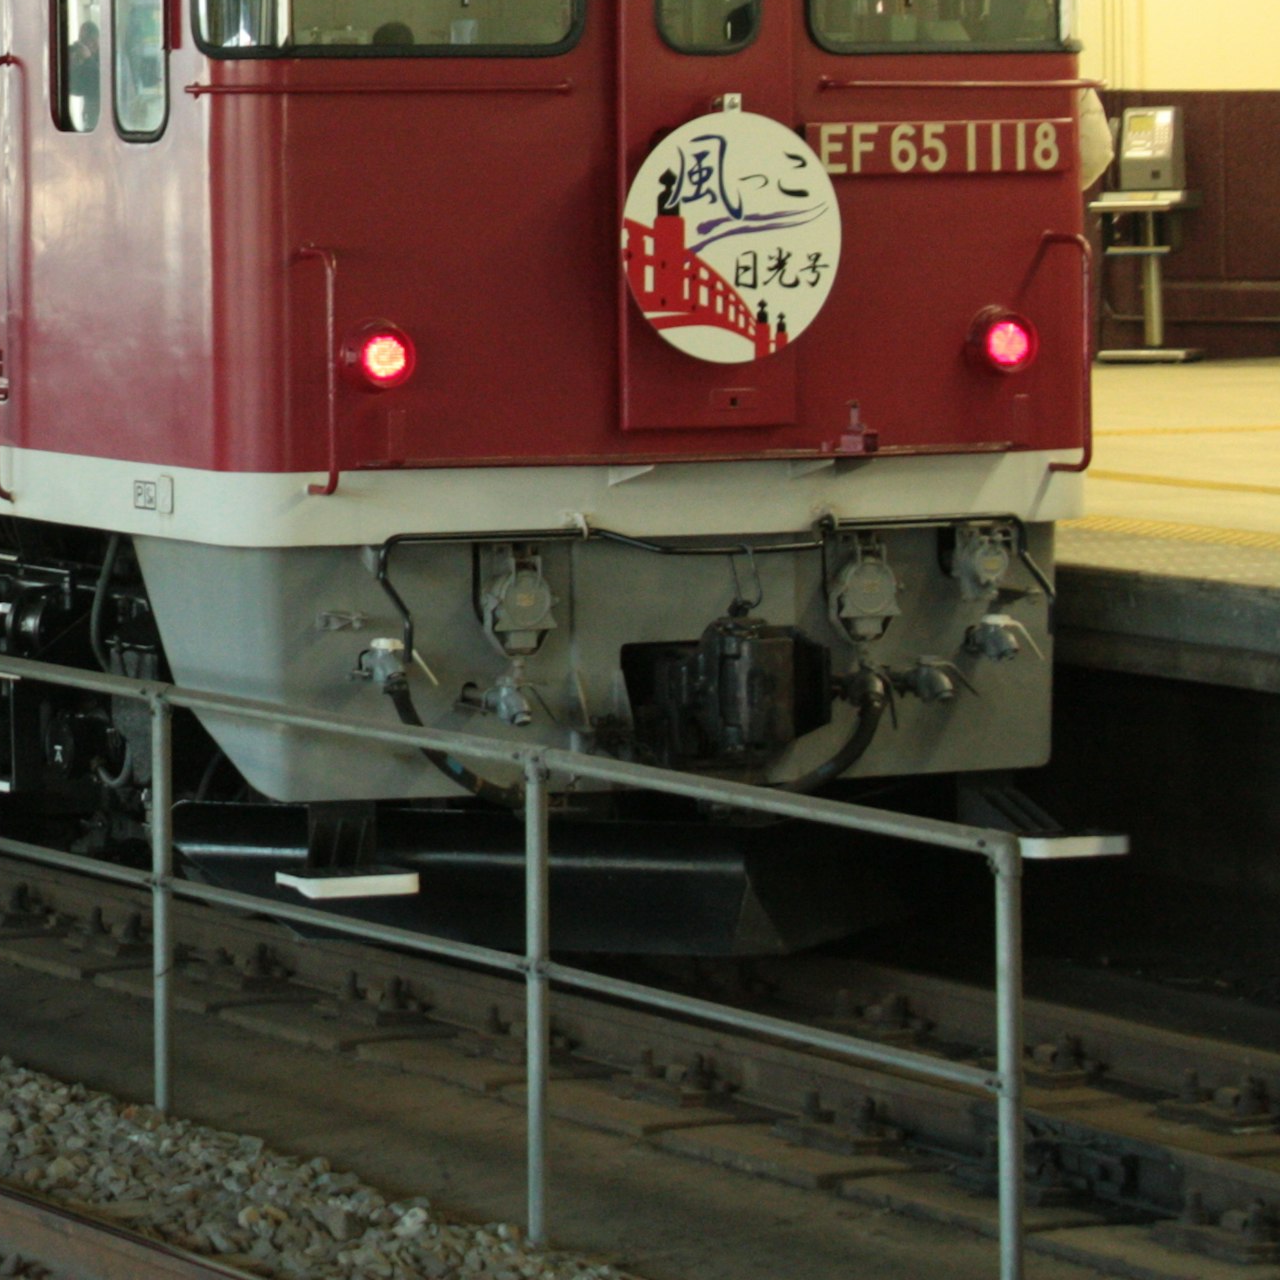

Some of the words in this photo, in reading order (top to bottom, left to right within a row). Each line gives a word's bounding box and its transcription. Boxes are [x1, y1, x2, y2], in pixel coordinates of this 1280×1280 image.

[820, 123, 879, 174] EF
[890, 123, 947, 173] 65
[966, 121, 1059, 170] 1118
[664, 134, 809, 220] 風っこ
[734, 246, 830, 290] 日光号
